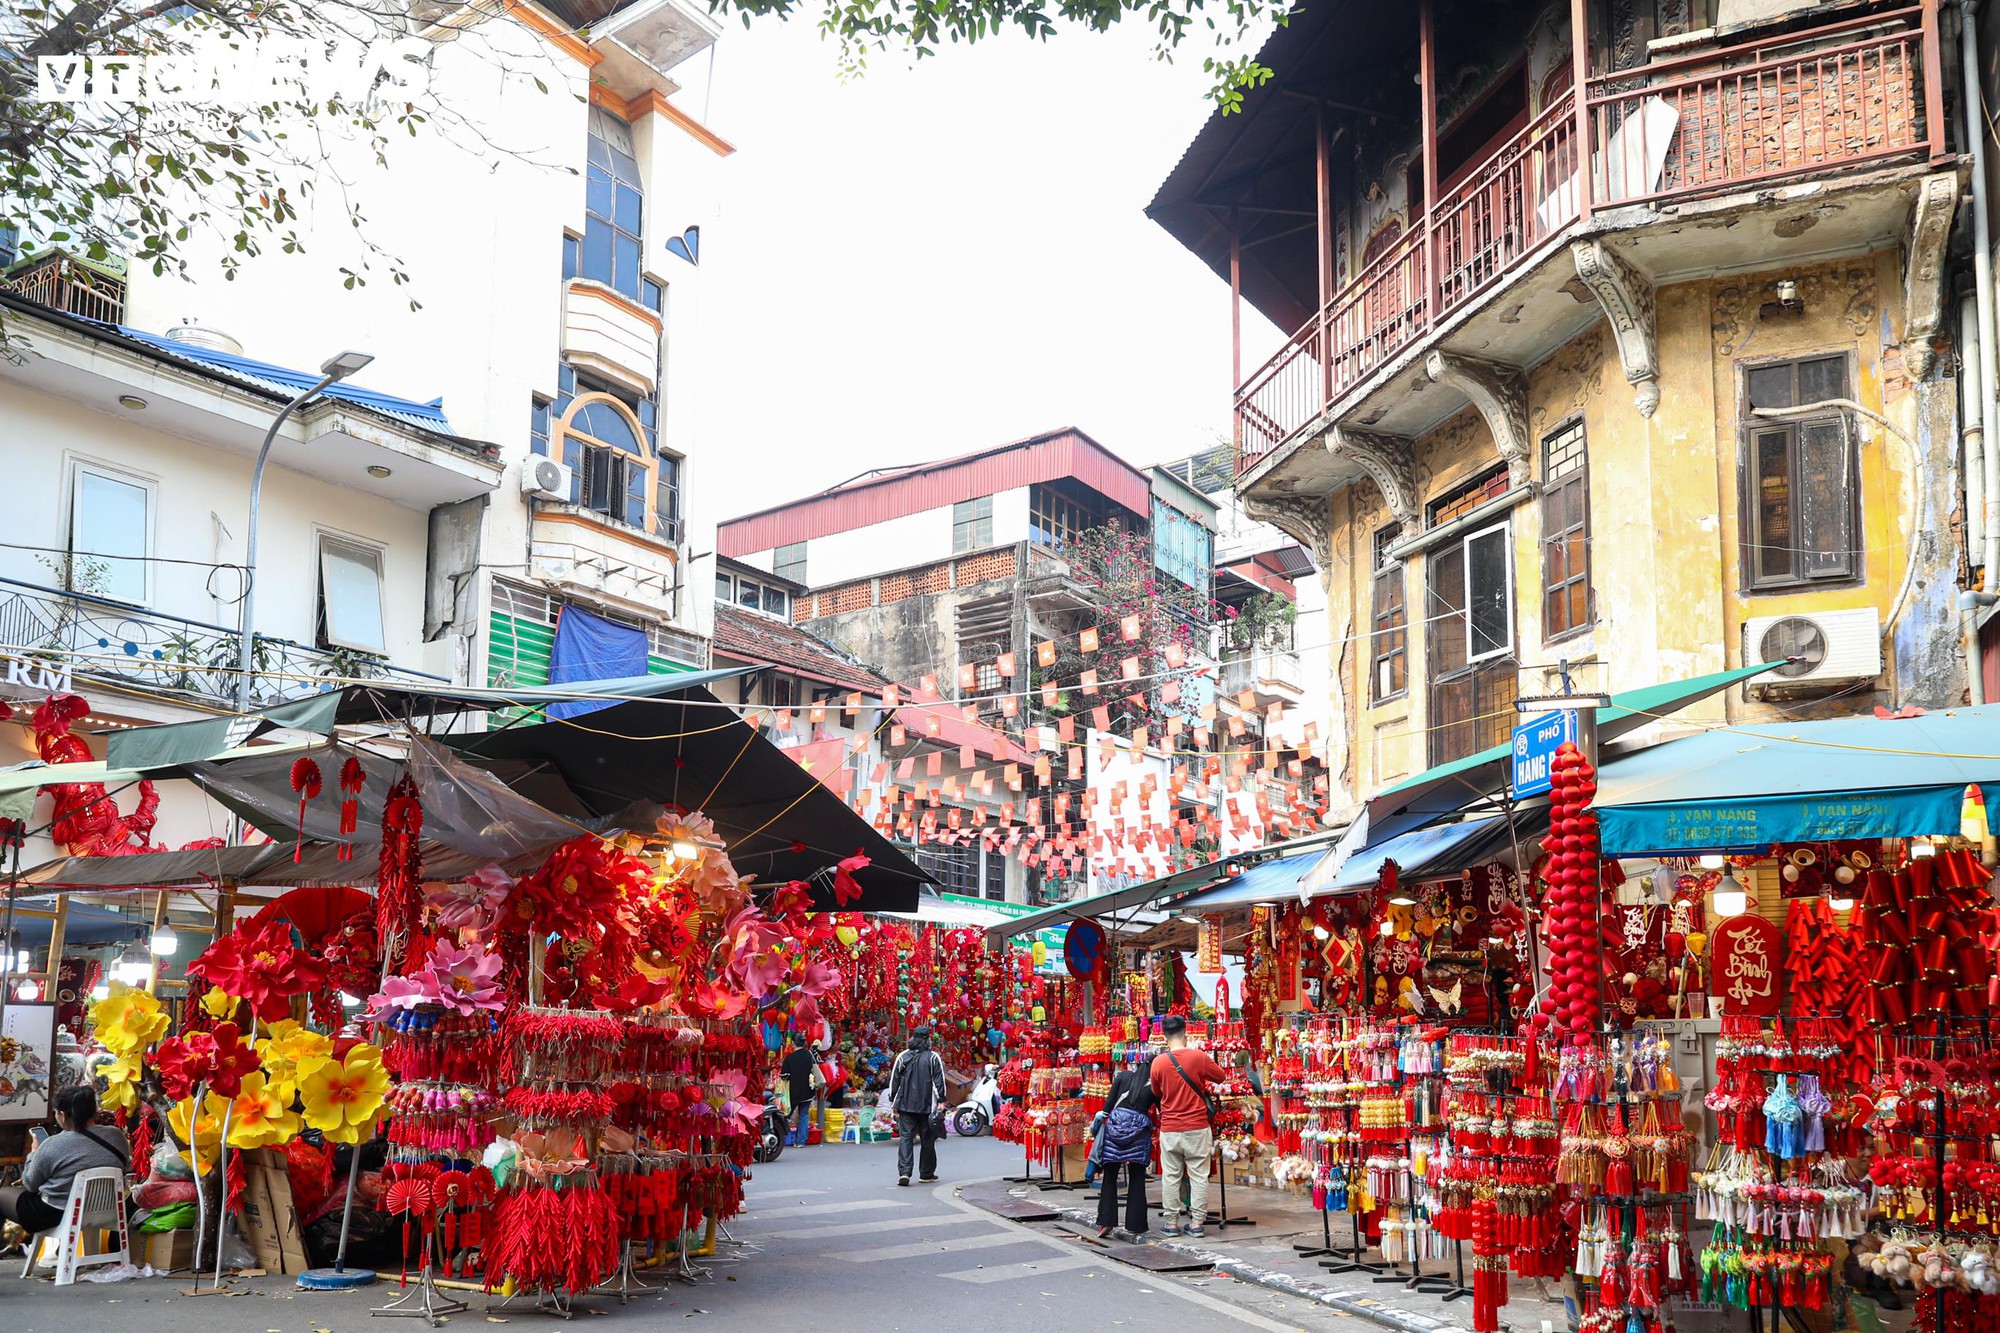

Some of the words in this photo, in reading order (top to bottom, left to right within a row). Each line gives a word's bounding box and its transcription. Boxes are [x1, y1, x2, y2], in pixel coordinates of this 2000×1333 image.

[0, 652, 75, 693] RM
[1538, 717, 1560, 743] PHỐ
[1517, 754, 1546, 786] HÀNG
[1726, 926, 1767, 955] Tết
[1725, 953, 1773, 979] Bình
